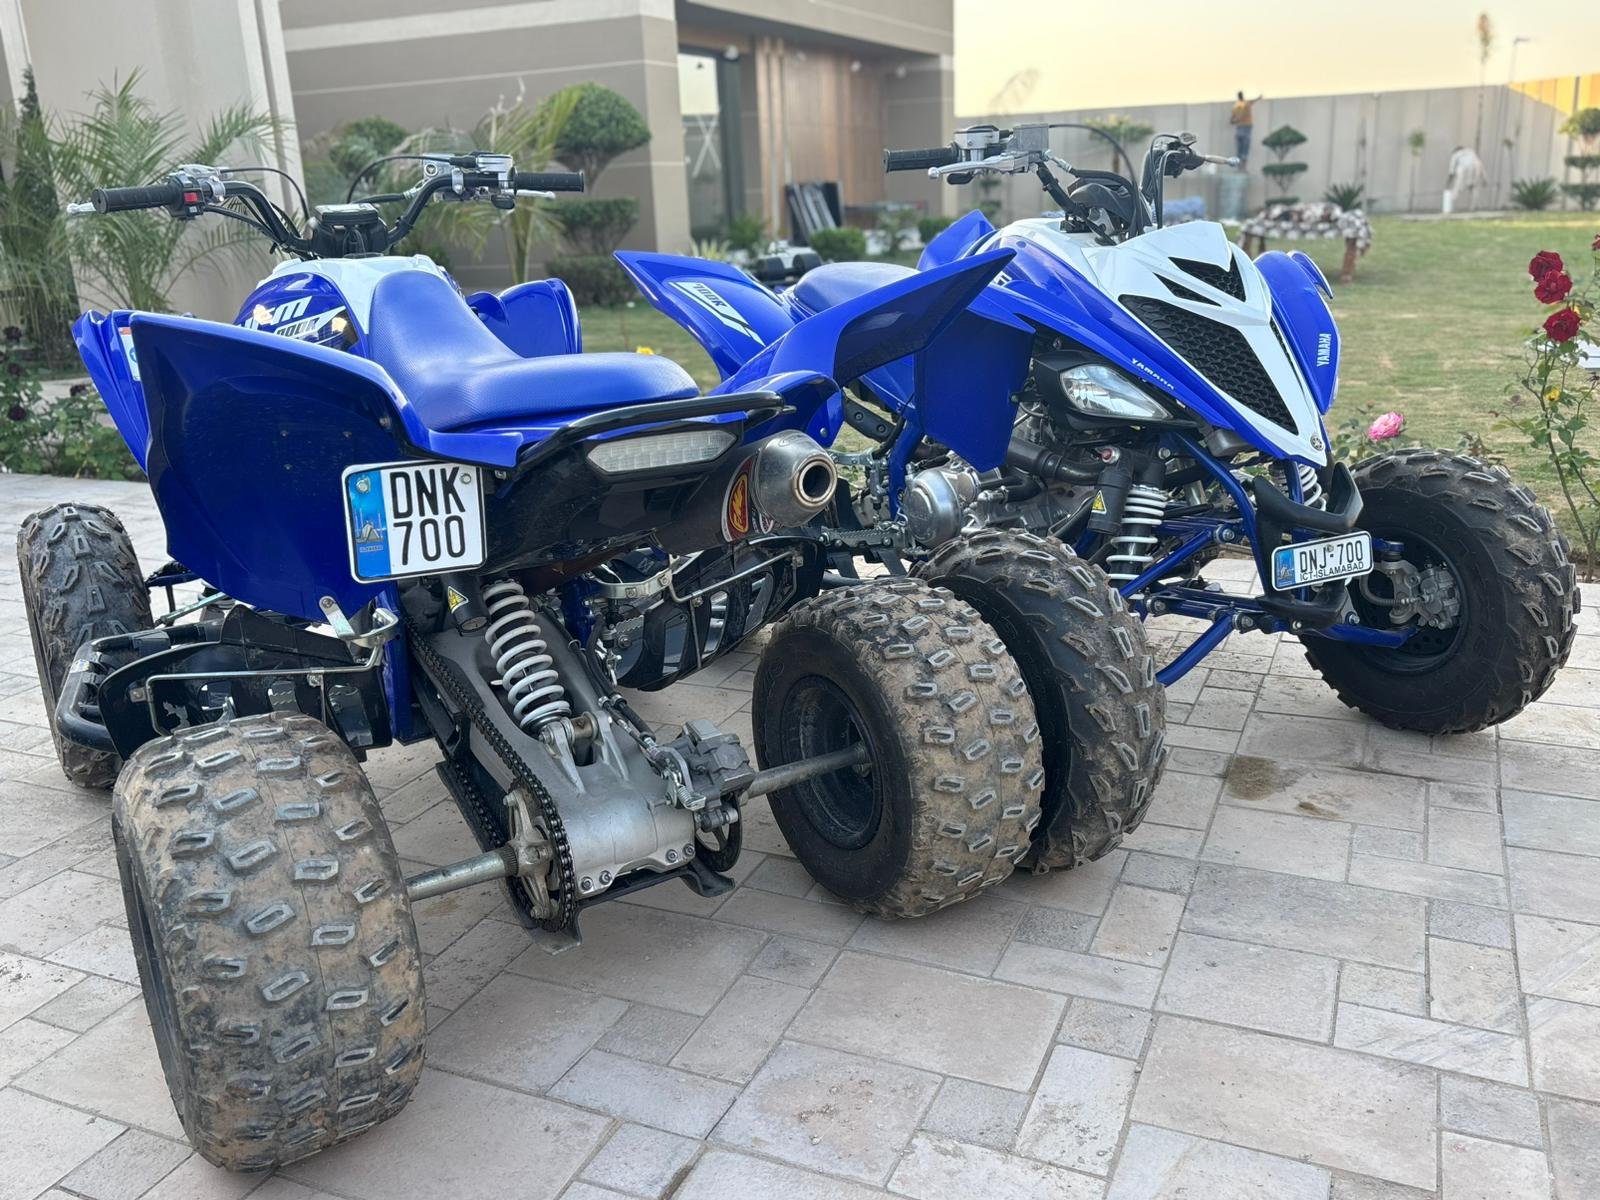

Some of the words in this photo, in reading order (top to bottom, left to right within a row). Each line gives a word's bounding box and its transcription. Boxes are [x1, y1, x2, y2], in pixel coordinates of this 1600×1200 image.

[1316, 333, 1332, 367] YAMAHA
[1131, 357, 1175, 390] YAMAHA
[389, 466, 466, 519] DNK
[393, 515, 466, 566] 700
[1300, 561, 1365, 582] ICT-ISLAMABAD
